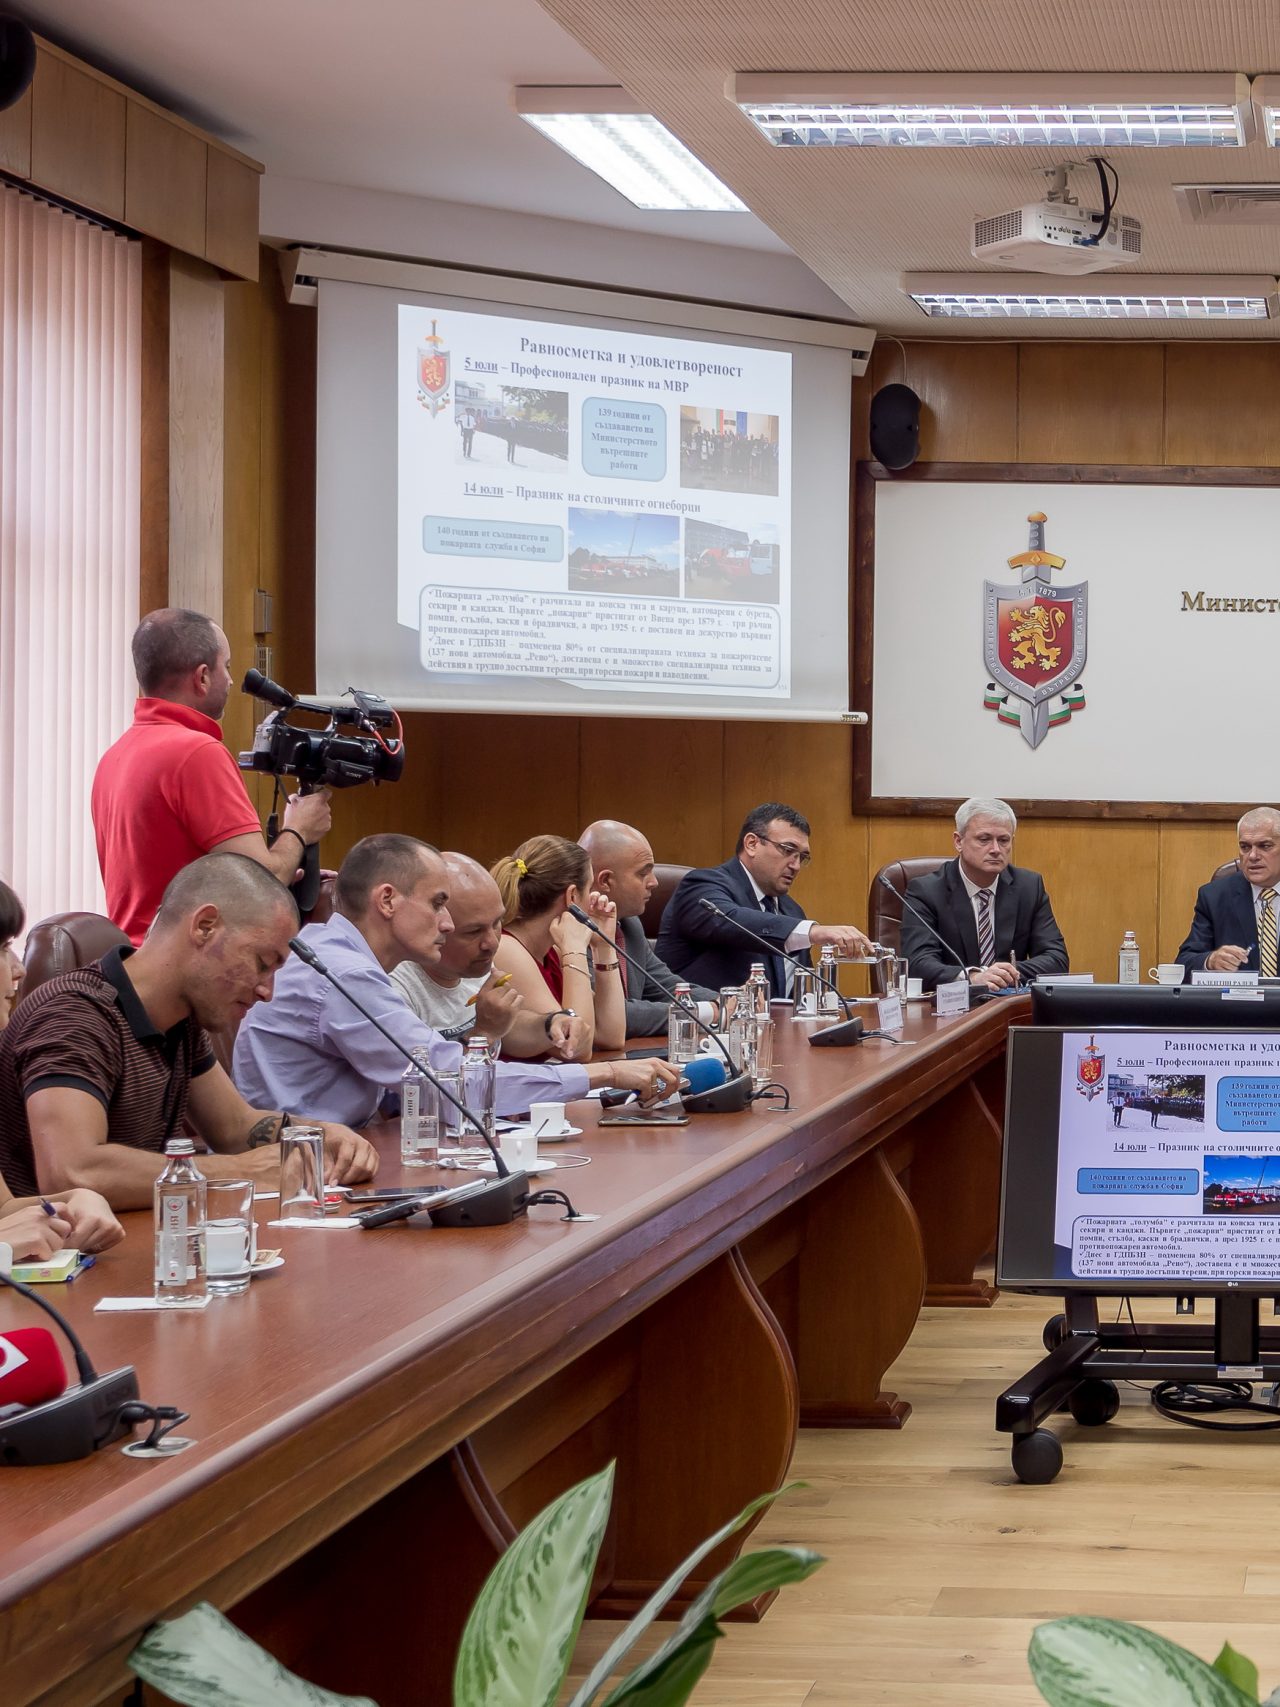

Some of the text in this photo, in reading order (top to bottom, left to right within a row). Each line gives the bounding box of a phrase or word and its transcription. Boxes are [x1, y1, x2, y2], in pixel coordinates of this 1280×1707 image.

[521, 338, 743, 377] Равносметка и удовлетвореност
[464, 357, 471, 370] 5
[474, 361, 498, 373] юли
[511, 362, 596, 382] Професионален
[600, 376, 645, 388] празник
[648, 381, 660, 389] на
[663, 380, 690, 392] МВР
[465, 482, 477, 495] 14
[480, 486, 504, 497] юли
[516, 486, 564, 501] Празник
[567, 493, 581, 502] на
[583, 495, 646, 507] столичните
[647, 500, 701, 514] огнеборци
[1039, 587, 1057, 598] 1879
[1165, 1040, 1245, 1051] Равносметка
[1250, 1043, 1257, 1051] и
[1117, 1057, 1122, 1067] 5
[1125, 1059, 1145, 1067] юли
[1155, 1058, 1230, 1068] Професионален
[1234, 1060, 1274, 1068] празник
[1114, 1142, 1125, 1152] 14
[1127, 1144, 1147, 1152] юли
[1158, 1143, 1200, 1153] Празник
